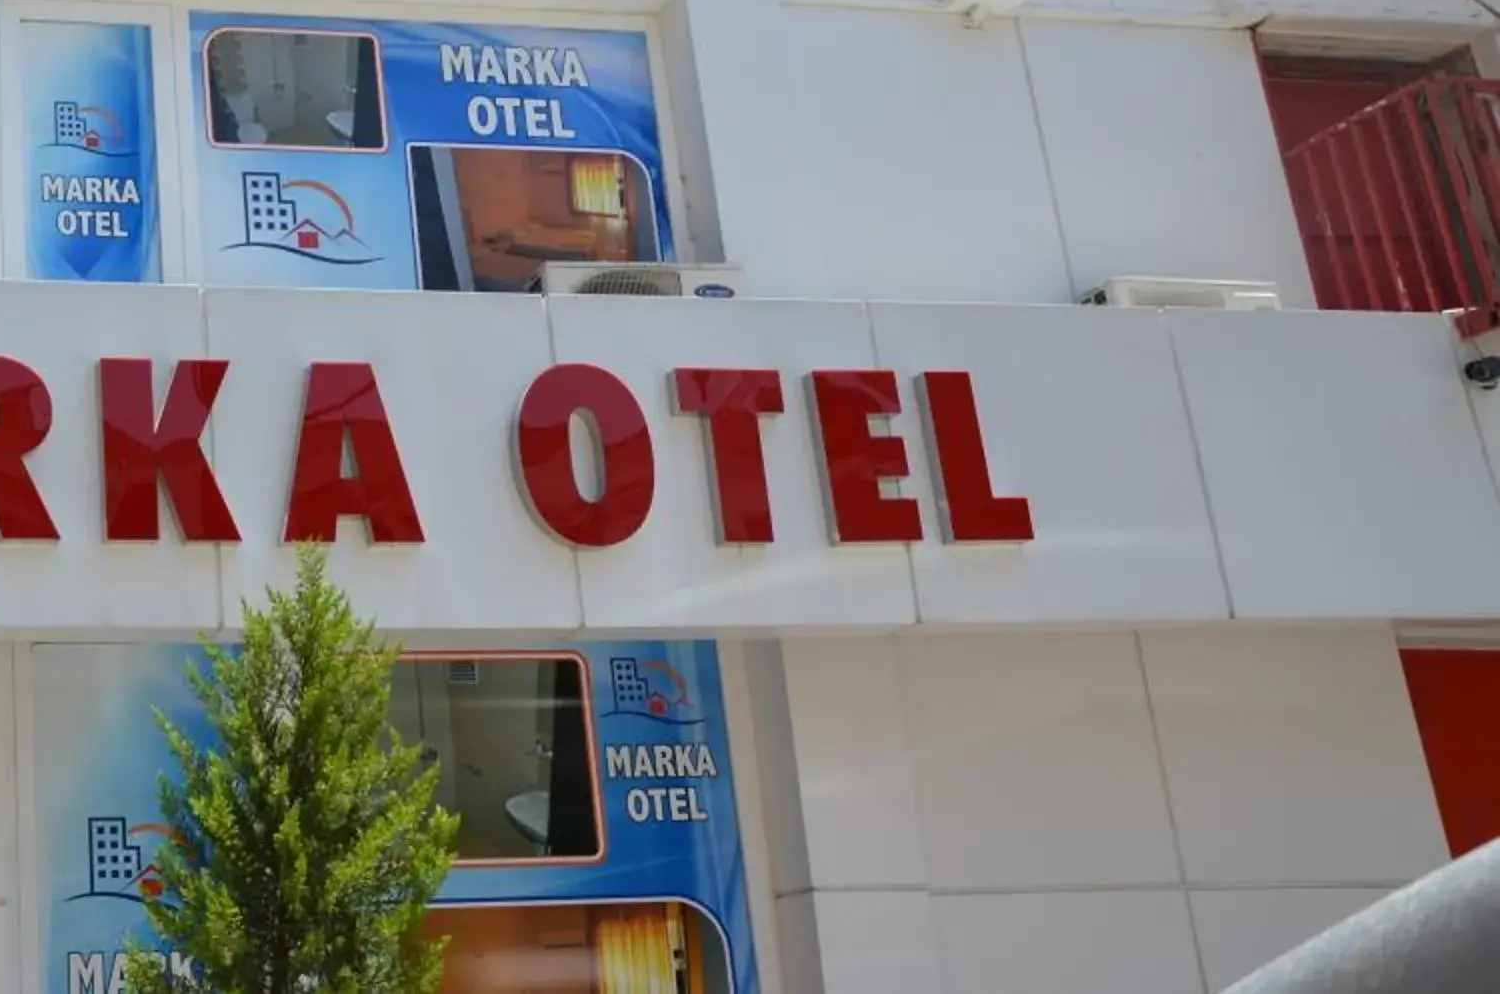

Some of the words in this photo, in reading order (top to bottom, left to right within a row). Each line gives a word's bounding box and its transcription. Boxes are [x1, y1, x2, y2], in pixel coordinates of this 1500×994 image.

[440, 43, 589, 88] MARKA
[467, 95, 577, 139] OTEL
[41, 174, 140, 205] MARKA
[56, 209, 128, 238] OTEL
[512, 363, 1035, 548] OTEL
[606, 743, 717, 779] MARKA
[626, 786, 708, 823] OTEL
